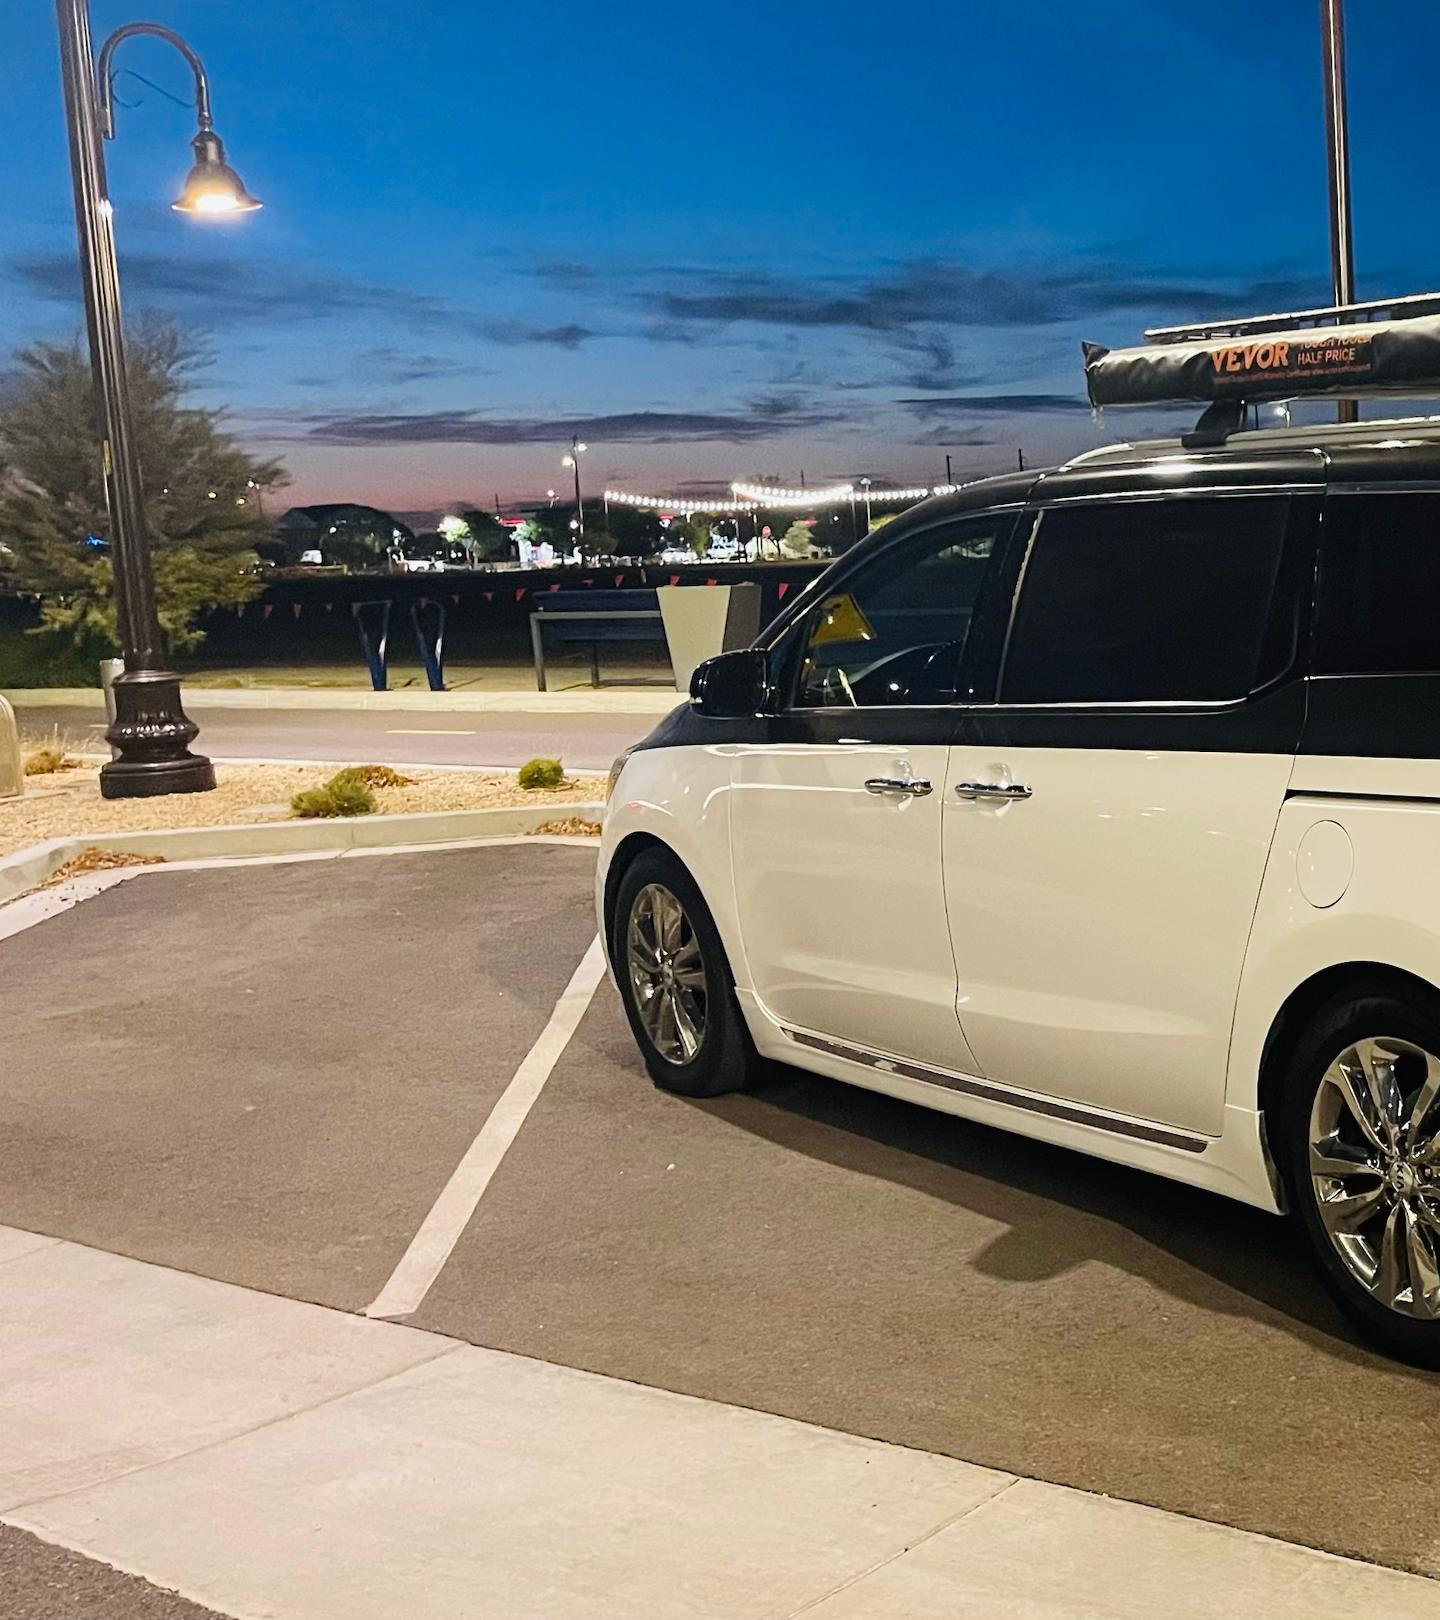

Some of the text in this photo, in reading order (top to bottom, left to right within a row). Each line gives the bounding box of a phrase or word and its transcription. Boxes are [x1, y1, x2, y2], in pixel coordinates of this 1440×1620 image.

[1211, 341, 1290, 373] VEVOR
[1297, 347, 1356, 365] HALF PRICE
